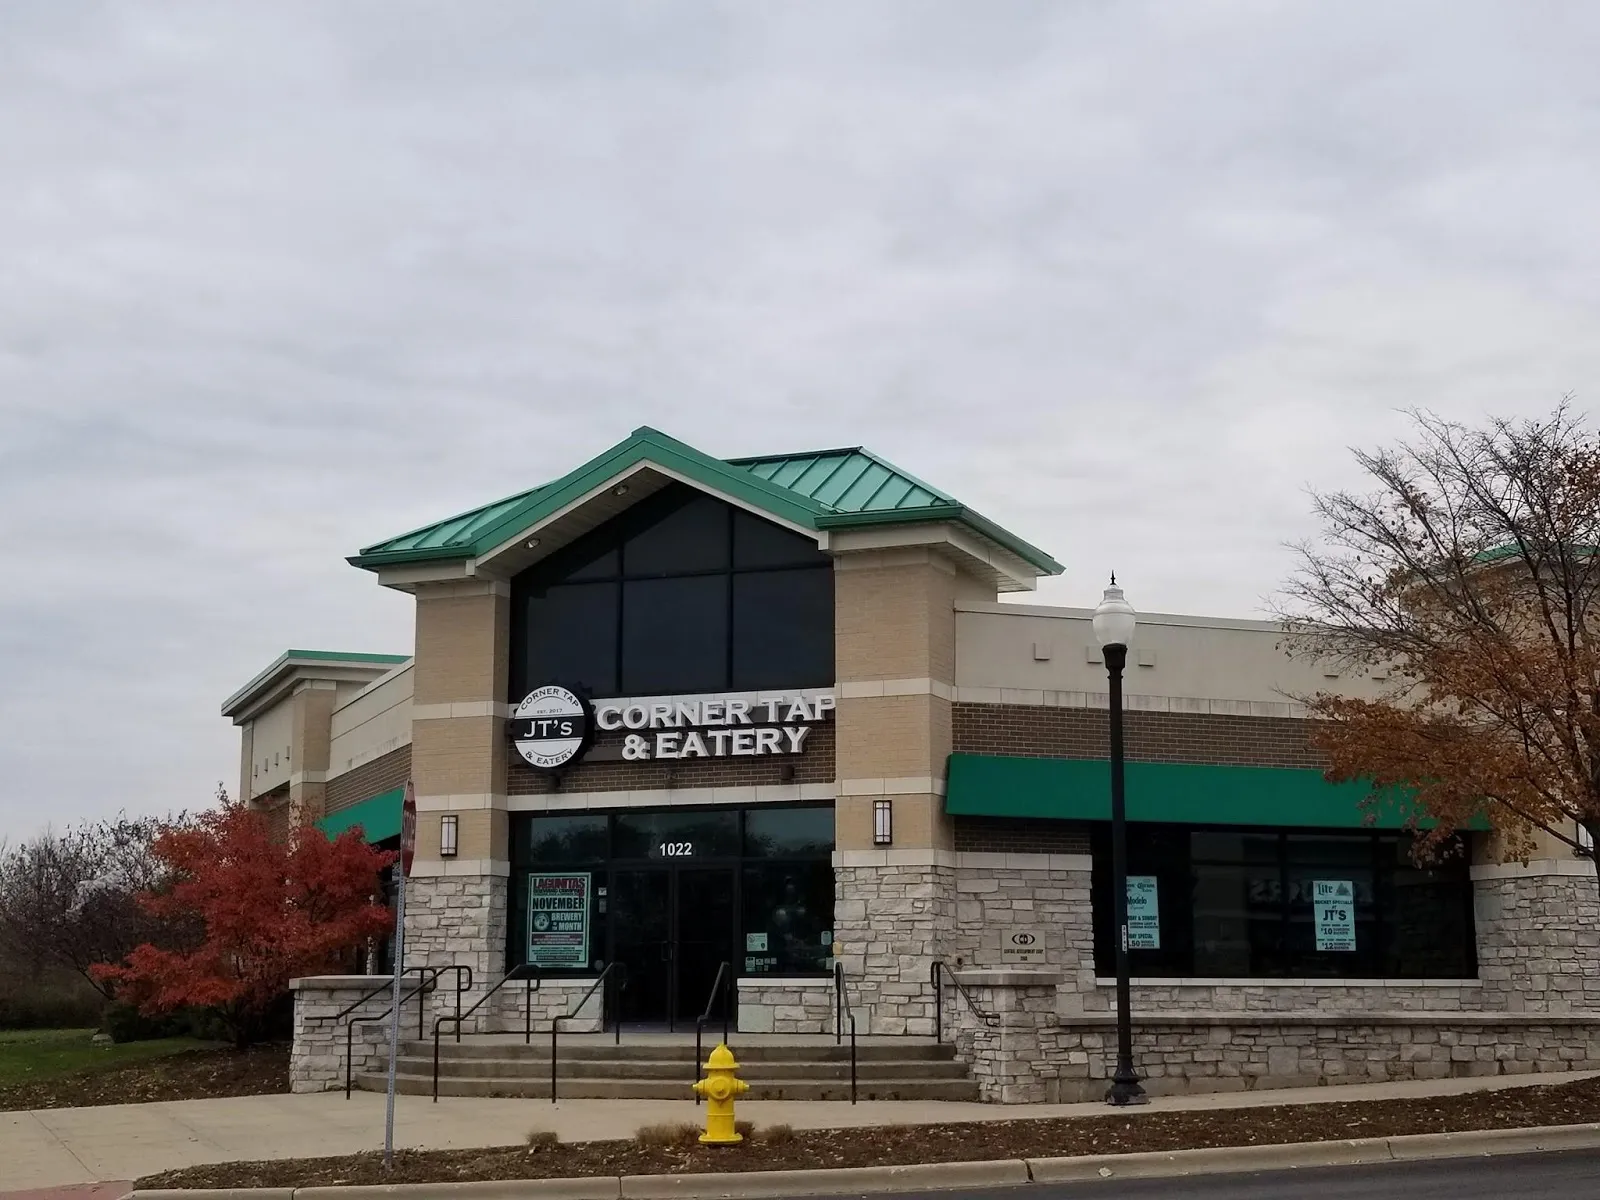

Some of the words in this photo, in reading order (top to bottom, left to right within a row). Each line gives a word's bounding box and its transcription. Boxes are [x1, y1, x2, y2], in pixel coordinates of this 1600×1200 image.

[521, 687, 560, 711] CORNER
[563, 690, 579, 708] TAP
[597, 699, 753, 731] CORNER
[761, 695, 836, 723] TAP
[523, 719, 573, 738] JT'S
[622, 733, 650, 761] &
[655, 726, 811, 760] EATERY
[525, 751, 534, 760] &
[536, 748, 573, 765] EATERY
[659, 842, 692, 856] 1022
[1317, 882, 1333, 896] Lite
[533, 897, 584, 910] NOVEMBER
[551, 912, 582, 921] BREWERY
[1323, 909, 1347, 921] JT'S
[559, 922, 582, 931] MONTH
